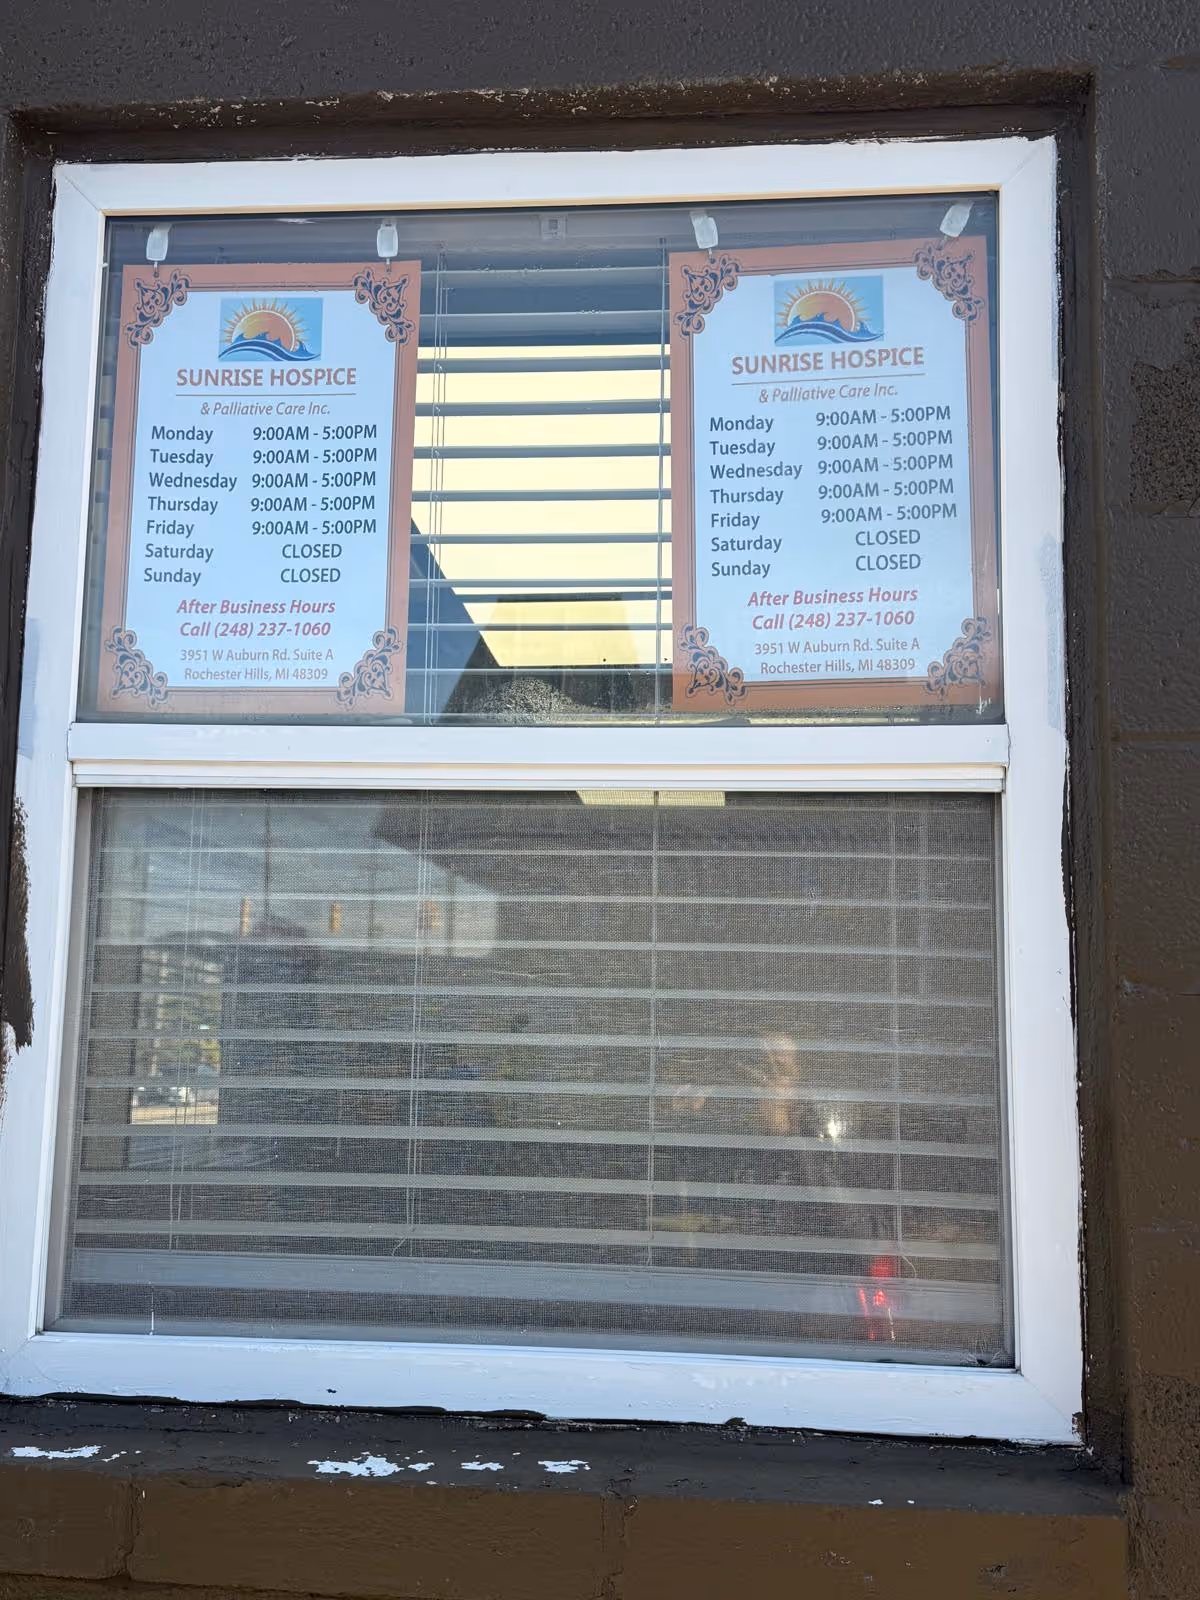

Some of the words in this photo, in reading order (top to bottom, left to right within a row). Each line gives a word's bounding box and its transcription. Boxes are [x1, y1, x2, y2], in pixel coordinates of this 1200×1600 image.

[732, 352, 823, 375] SUNRISE
[831, 347, 924, 369] HOSPICE
[177, 369, 263, 386] SUNRISE
[271, 368, 356, 386] HOSPICE
[759, 389, 768, 403] &
[772, 386, 835, 402] Palliative
[839, 385, 870, 398] Care
[874, 383, 898, 396] Inc.
[201, 402, 210, 415] &
[213, 402, 273, 415] Palliative
[276, 402, 305, 415] Care
[308, 402, 330, 415] Inc.
[710, 415, 774, 433] Monday
[816, 409, 876, 426] 9:00AM
[891, 405, 950, 423] 5:00PM
[152, 426, 213, 444] Monday
[253, 426, 309, 440] 9:00AM
[323, 424, 376, 440] 5:00PM
[709, 439, 775, 457] Tuesday
[818, 433, 878, 450] 9:00AM
[893, 430, 952, 447] 5:00PM
[150, 449, 213, 467] Tuesday
[253, 449, 309, 464] 9:00AM
[323, 448, 376, 463] 5:00PM
[710, 461, 803, 479] Wednesday
[818, 457, 878, 474] 9:00AM
[893, 454, 953, 471] 5:00PM
[149, 472, 237, 492] Wednesday
[252, 473, 308, 488] 9:00AM
[322, 471, 375, 487] 5:00PM
[710, 487, 784, 505] Thursday
[818, 482, 879, 499] 9:00AM
[894, 478, 953, 496] 5:00PM
[148, 496, 218, 515] Thursday
[251, 497, 307, 512] 9:00AM
[321, 496, 374, 511] 5:00PM
[711, 512, 760, 530] Friday
[821, 506, 882, 523] 9:00AM
[897, 503, 957, 520] 5:00PM
[147, 520, 194, 538] Friday
[252, 521, 308, 535] 9:00AM
[322, 519, 376, 534] 5:00PM
[711, 535, 782, 553] Saturday
[856, 529, 920, 546] CLOSED
[145, 543, 214, 563] Saturday
[282, 544, 342, 558] CLOSED
[712, 560, 770, 578] Sunday
[856, 554, 921, 571] CLOSED
[144, 568, 201, 586] Sunday
[281, 568, 340, 583] CLOSED
[747, 591, 789, 606] After
[793, 589, 864, 605] Business
[868, 587, 918, 602] Hours
[177, 599, 217, 614] After
[220, 600, 286, 614] Business
[290, 600, 335, 613] Hours
[180, 621, 211, 636] Call
[215, 622, 253, 638] (248)
[257, 622, 331, 636] 237-1060
[752, 614, 784, 630] Call
[789, 612, 830, 630] (248)
[835, 610, 914, 627] 237-1060
[180, 649, 208, 661] 3951
[212, 649, 223, 661] W
[226, 649, 269, 661] Auburn
[272, 648, 290, 661] Rd.
[293, 648, 323, 661] Suite
[325, 648, 334, 660] A
[755, 642, 783, 655] 3951
[788, 641, 800, 653] W
[804, 640, 849, 653] Auburn
[853, 639, 873, 651] Rd.
[876, 638, 907, 651] Suite
[911, 637, 920, 650] A
[184, 668, 242, 680] Rochester
[244, 668, 272, 681] Hills,
[275, 668, 289, 680] MI
[292, 668, 328, 680] 48309
[760, 661, 821, 674] Rochester
[825, 659, 855, 672] Hills,
[858, 659, 873, 671] MI
[876, 658, 915, 671] 48309
